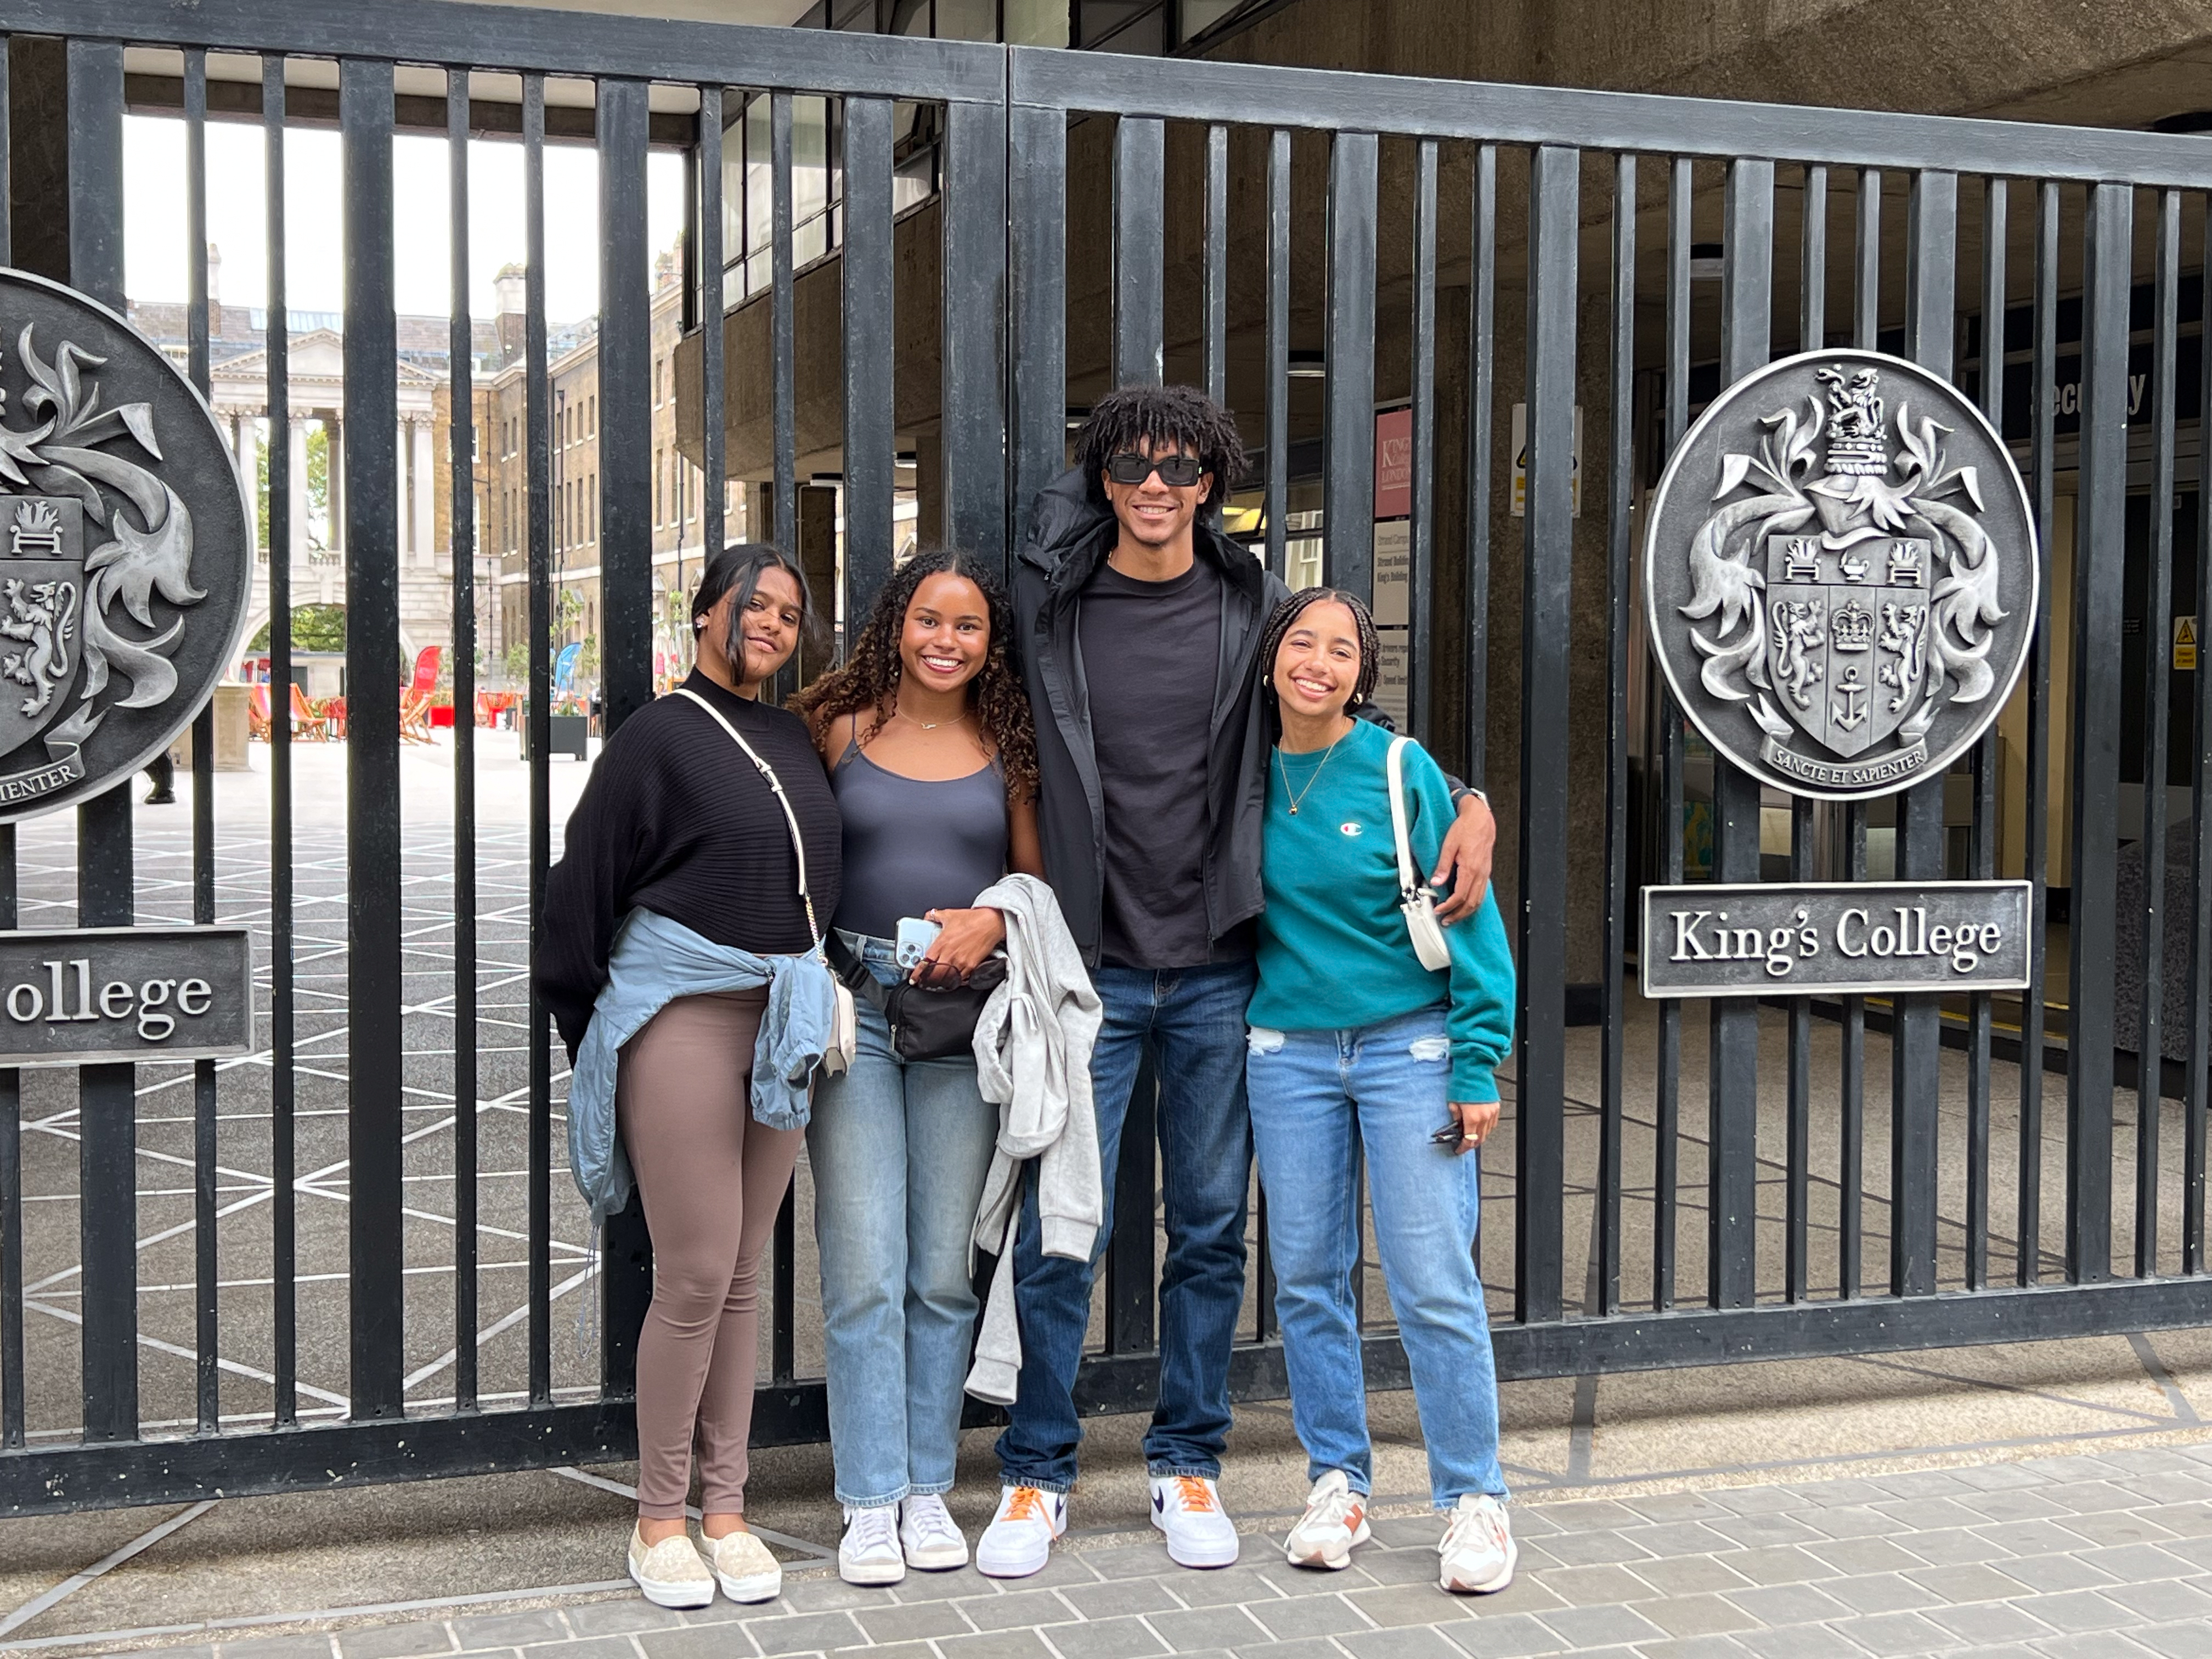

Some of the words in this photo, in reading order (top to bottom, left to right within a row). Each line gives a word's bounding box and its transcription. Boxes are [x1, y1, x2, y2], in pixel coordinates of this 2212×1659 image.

[1773, 750, 1826, 781] SANCTE
[1830, 769, 1848, 783] ET
[1852, 750, 1924, 784] SAPIENTER
[1669, 909, 1819, 976] King's
[1836, 907, 2001, 973] College
[7, 958, 212, 1041] ollege
